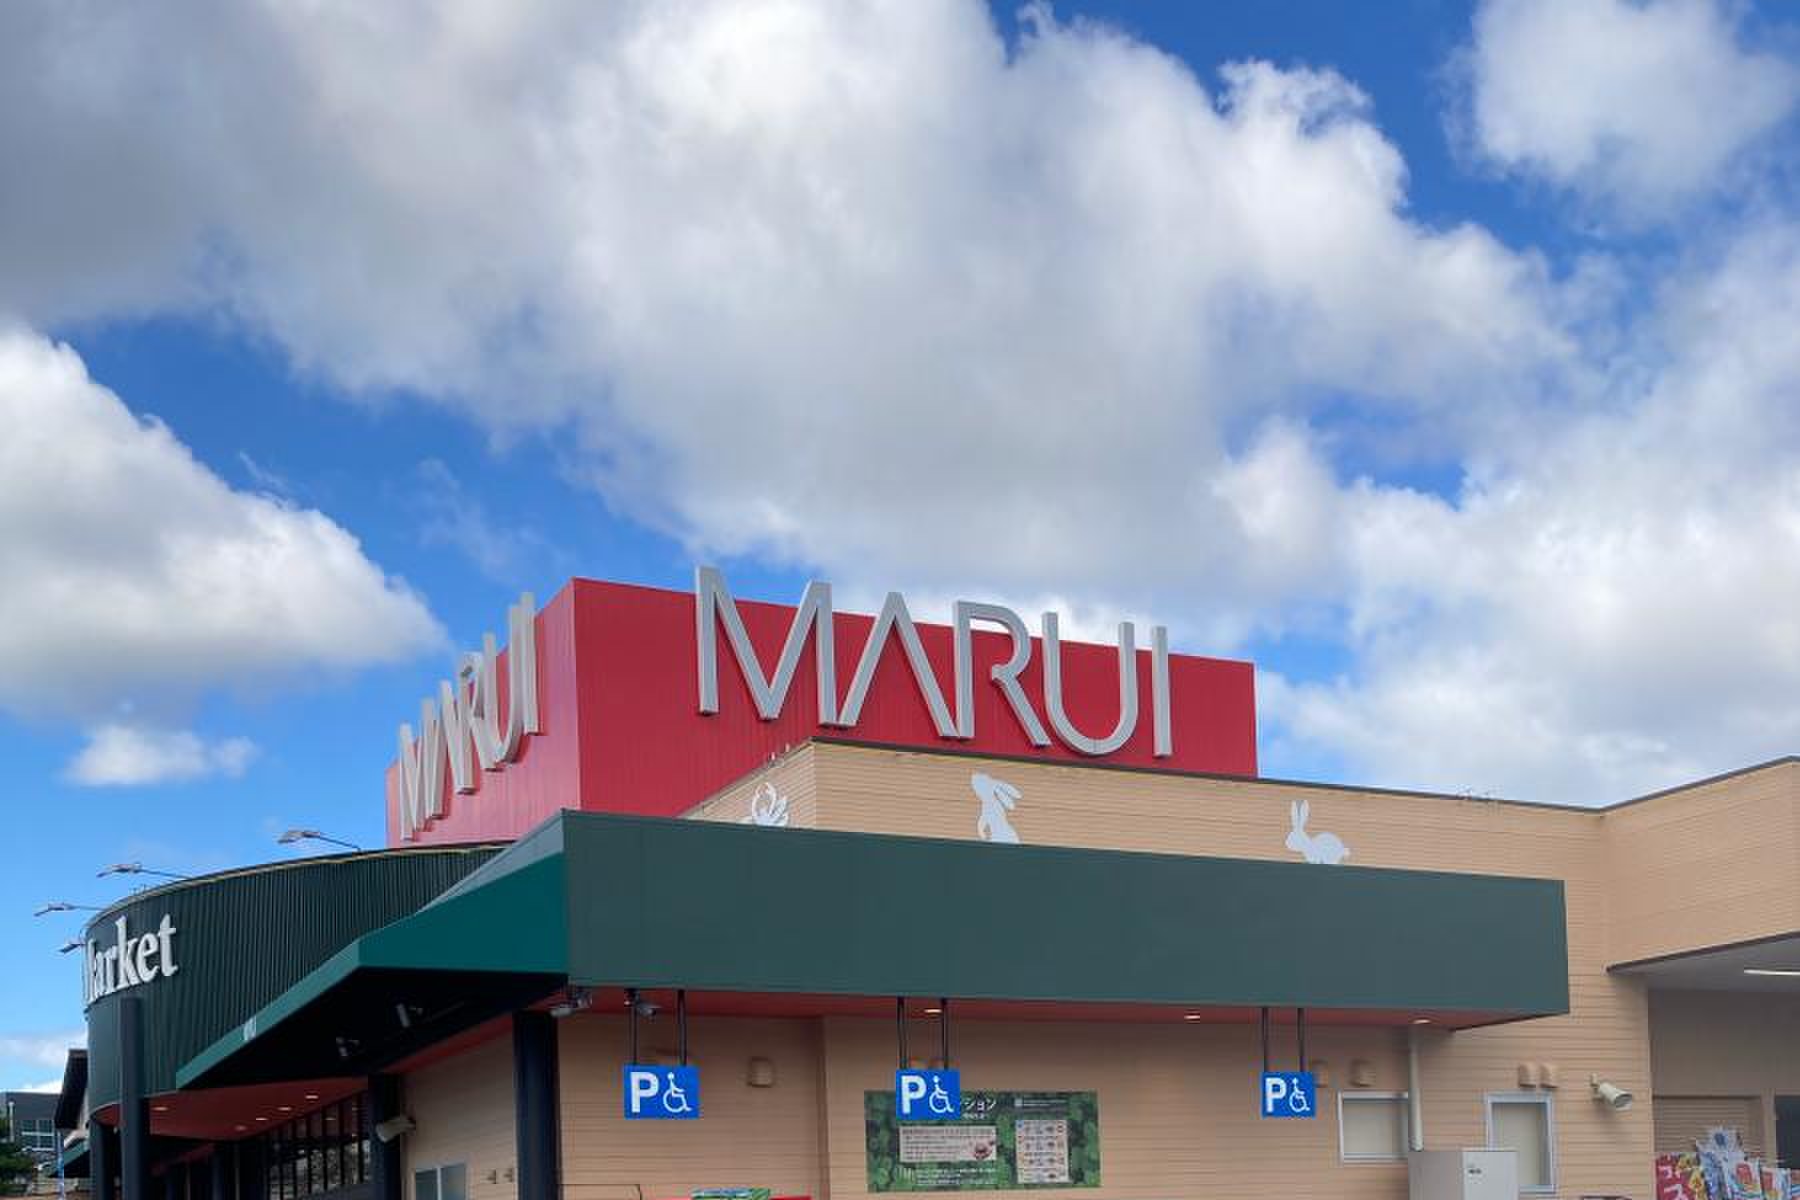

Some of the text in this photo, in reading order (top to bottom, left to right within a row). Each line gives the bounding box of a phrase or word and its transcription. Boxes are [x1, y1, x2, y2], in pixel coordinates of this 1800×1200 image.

[694, 565, 1173, 758] MARUI
[398, 591, 541, 841] MARUI
[630, 1072, 659, 1112] P
[900, 1075, 928, 1114] P
[1264, 1077, 1285, 1113] P
